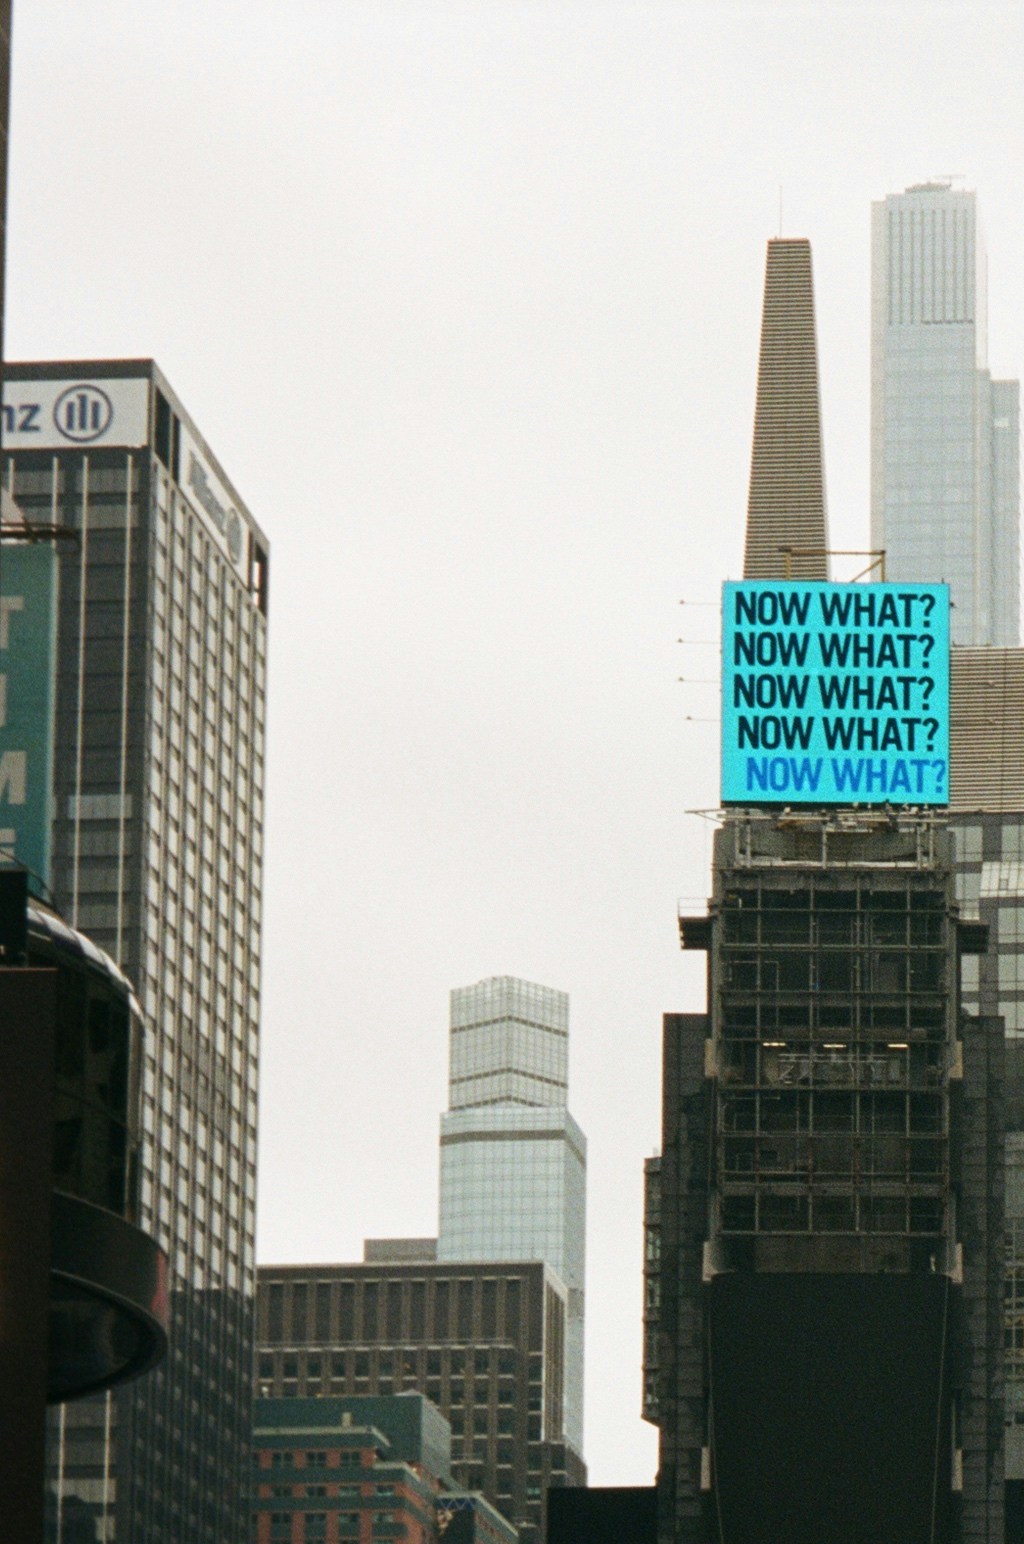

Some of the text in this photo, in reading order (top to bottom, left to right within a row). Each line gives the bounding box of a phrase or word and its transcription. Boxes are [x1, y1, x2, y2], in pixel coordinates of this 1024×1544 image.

[735, 591, 936, 628] NOW WHAT?
[734, 632, 935, 668] NOW WHAT?
[733, 674, 935, 711] NOW WHAT?
[738, 715, 939, 752] NOW WHAT?
[746, 757, 946, 793] NOW WHAT?
